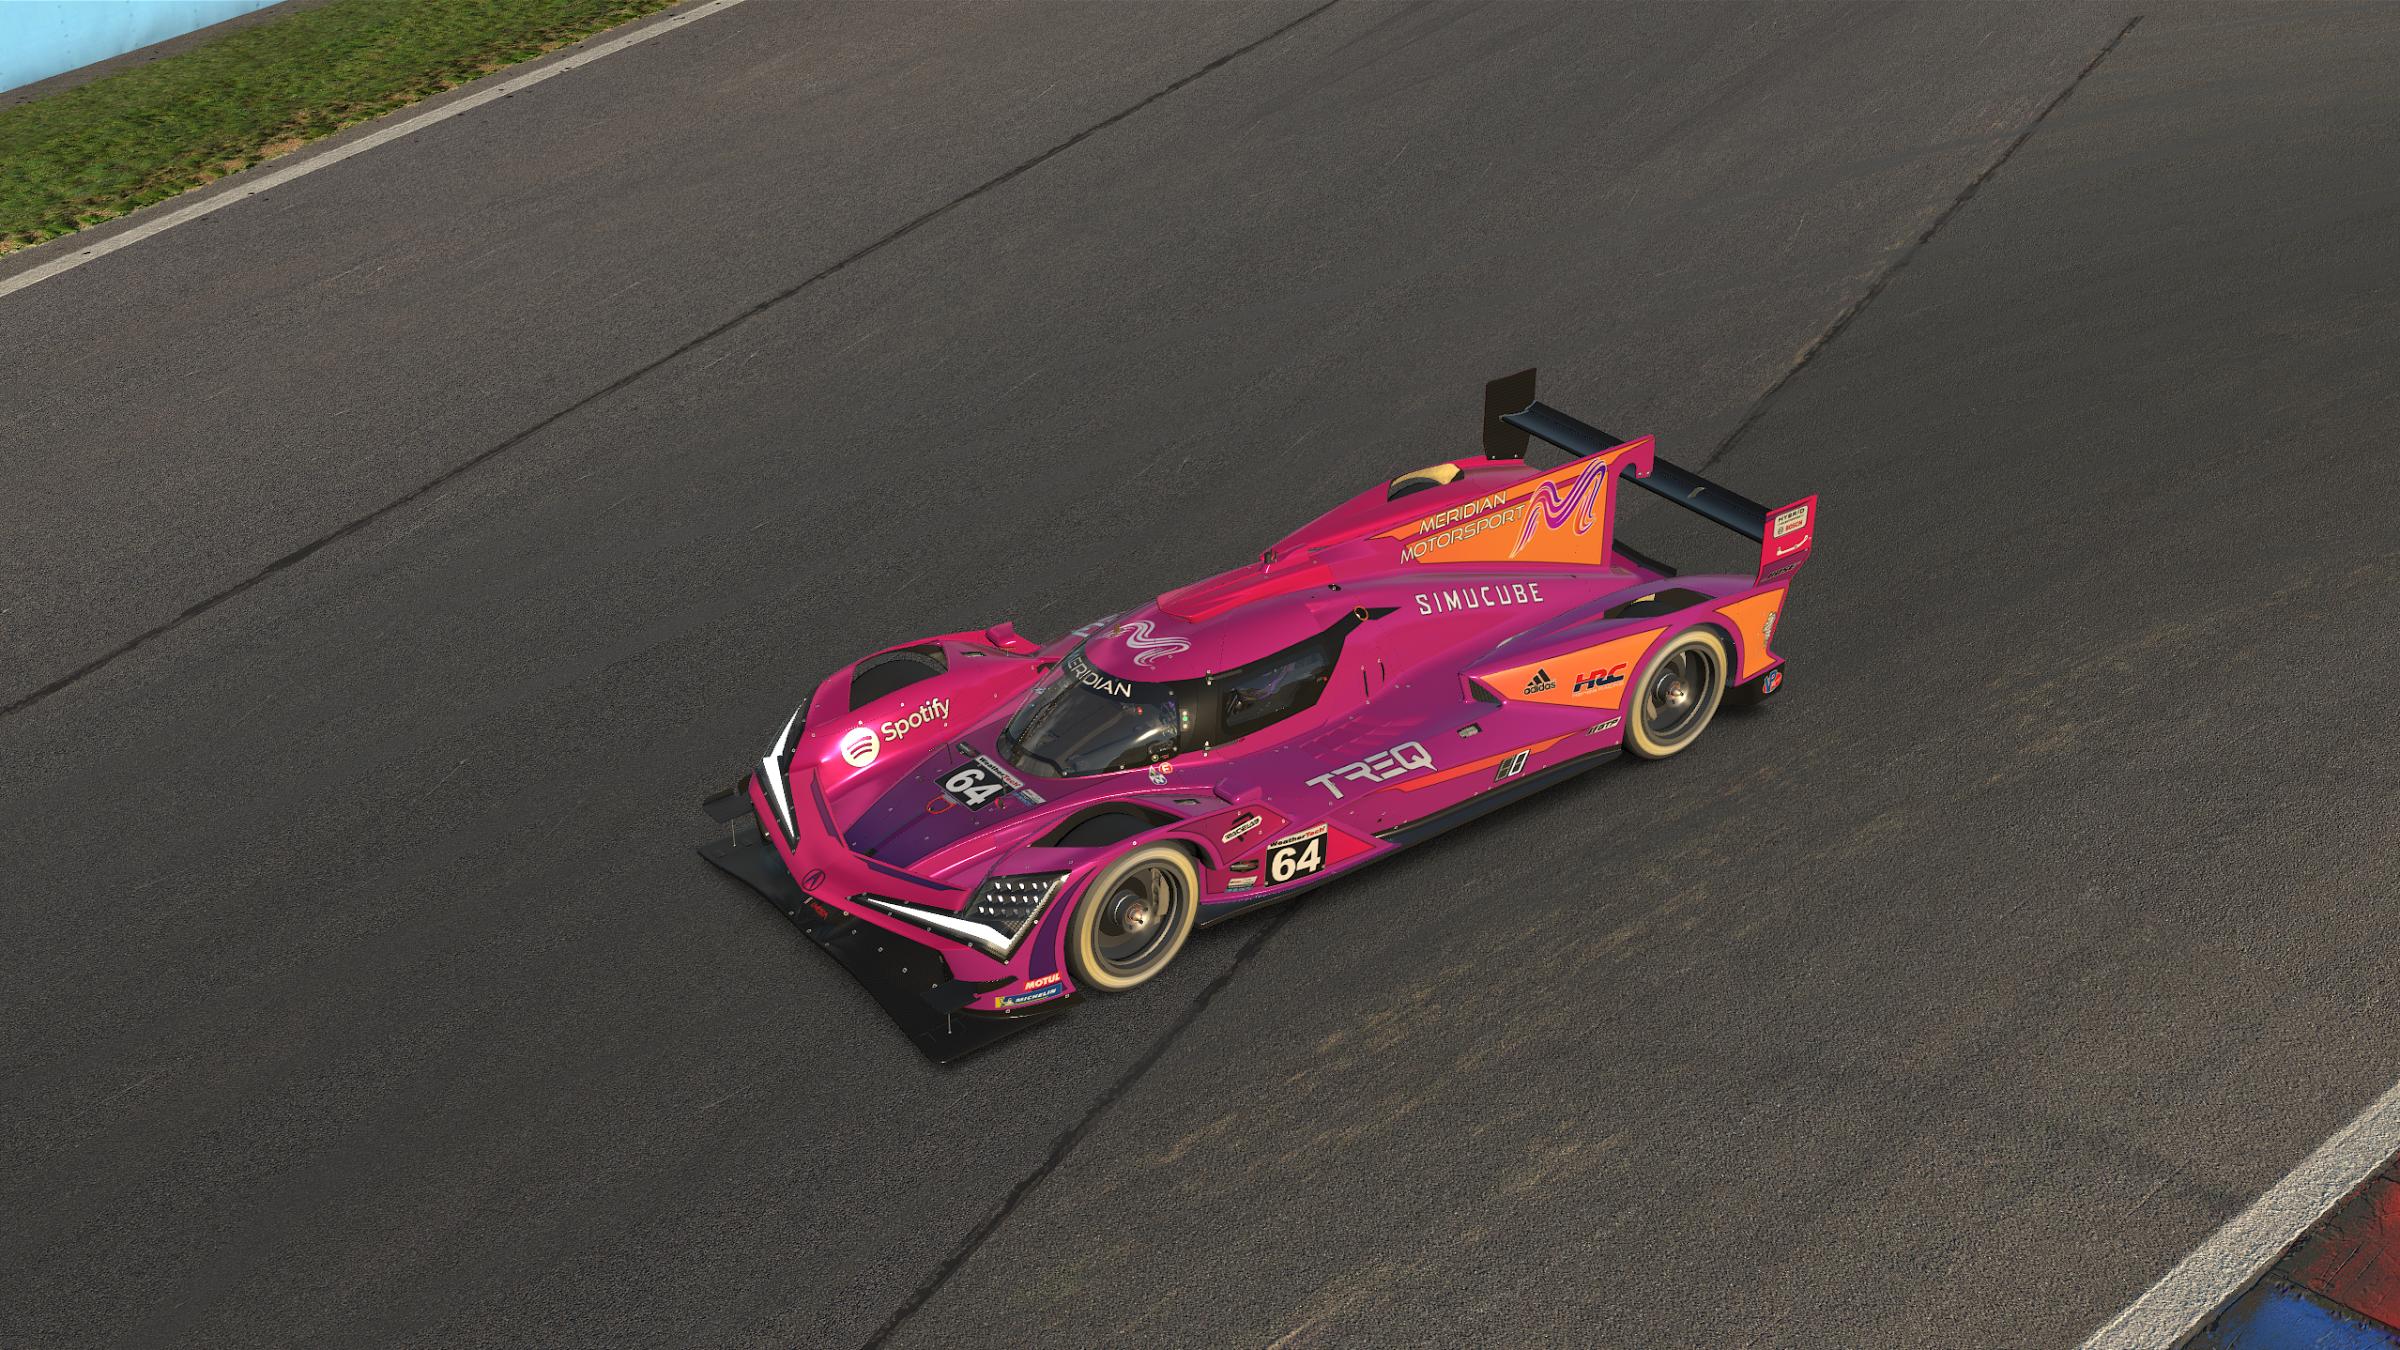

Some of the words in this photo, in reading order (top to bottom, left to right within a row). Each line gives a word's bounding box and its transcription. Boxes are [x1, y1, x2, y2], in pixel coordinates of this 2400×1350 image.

[1419, 491, 1507, 535] MERIDIAN
[1400, 504, 1525, 565] MOTORSPORT
[1415, 582, 1544, 616] SIMUCUBE
[1524, 681, 1556, 695] adidas
[1573, 663, 1627, 692] HRC
[880, 697, 950, 742] Spotify
[945, 768, 1004, 806] 64
[979, 756, 1021, 788] WeatherTech
[1305, 741, 1438, 800] TREQ
[1270, 826, 1327, 847] WeatherTech
[1271, 837, 1321, 882] 64
[1015, 988, 1057, 1003] MICHELIN
[1024, 972, 1061, 991] MOTUL
